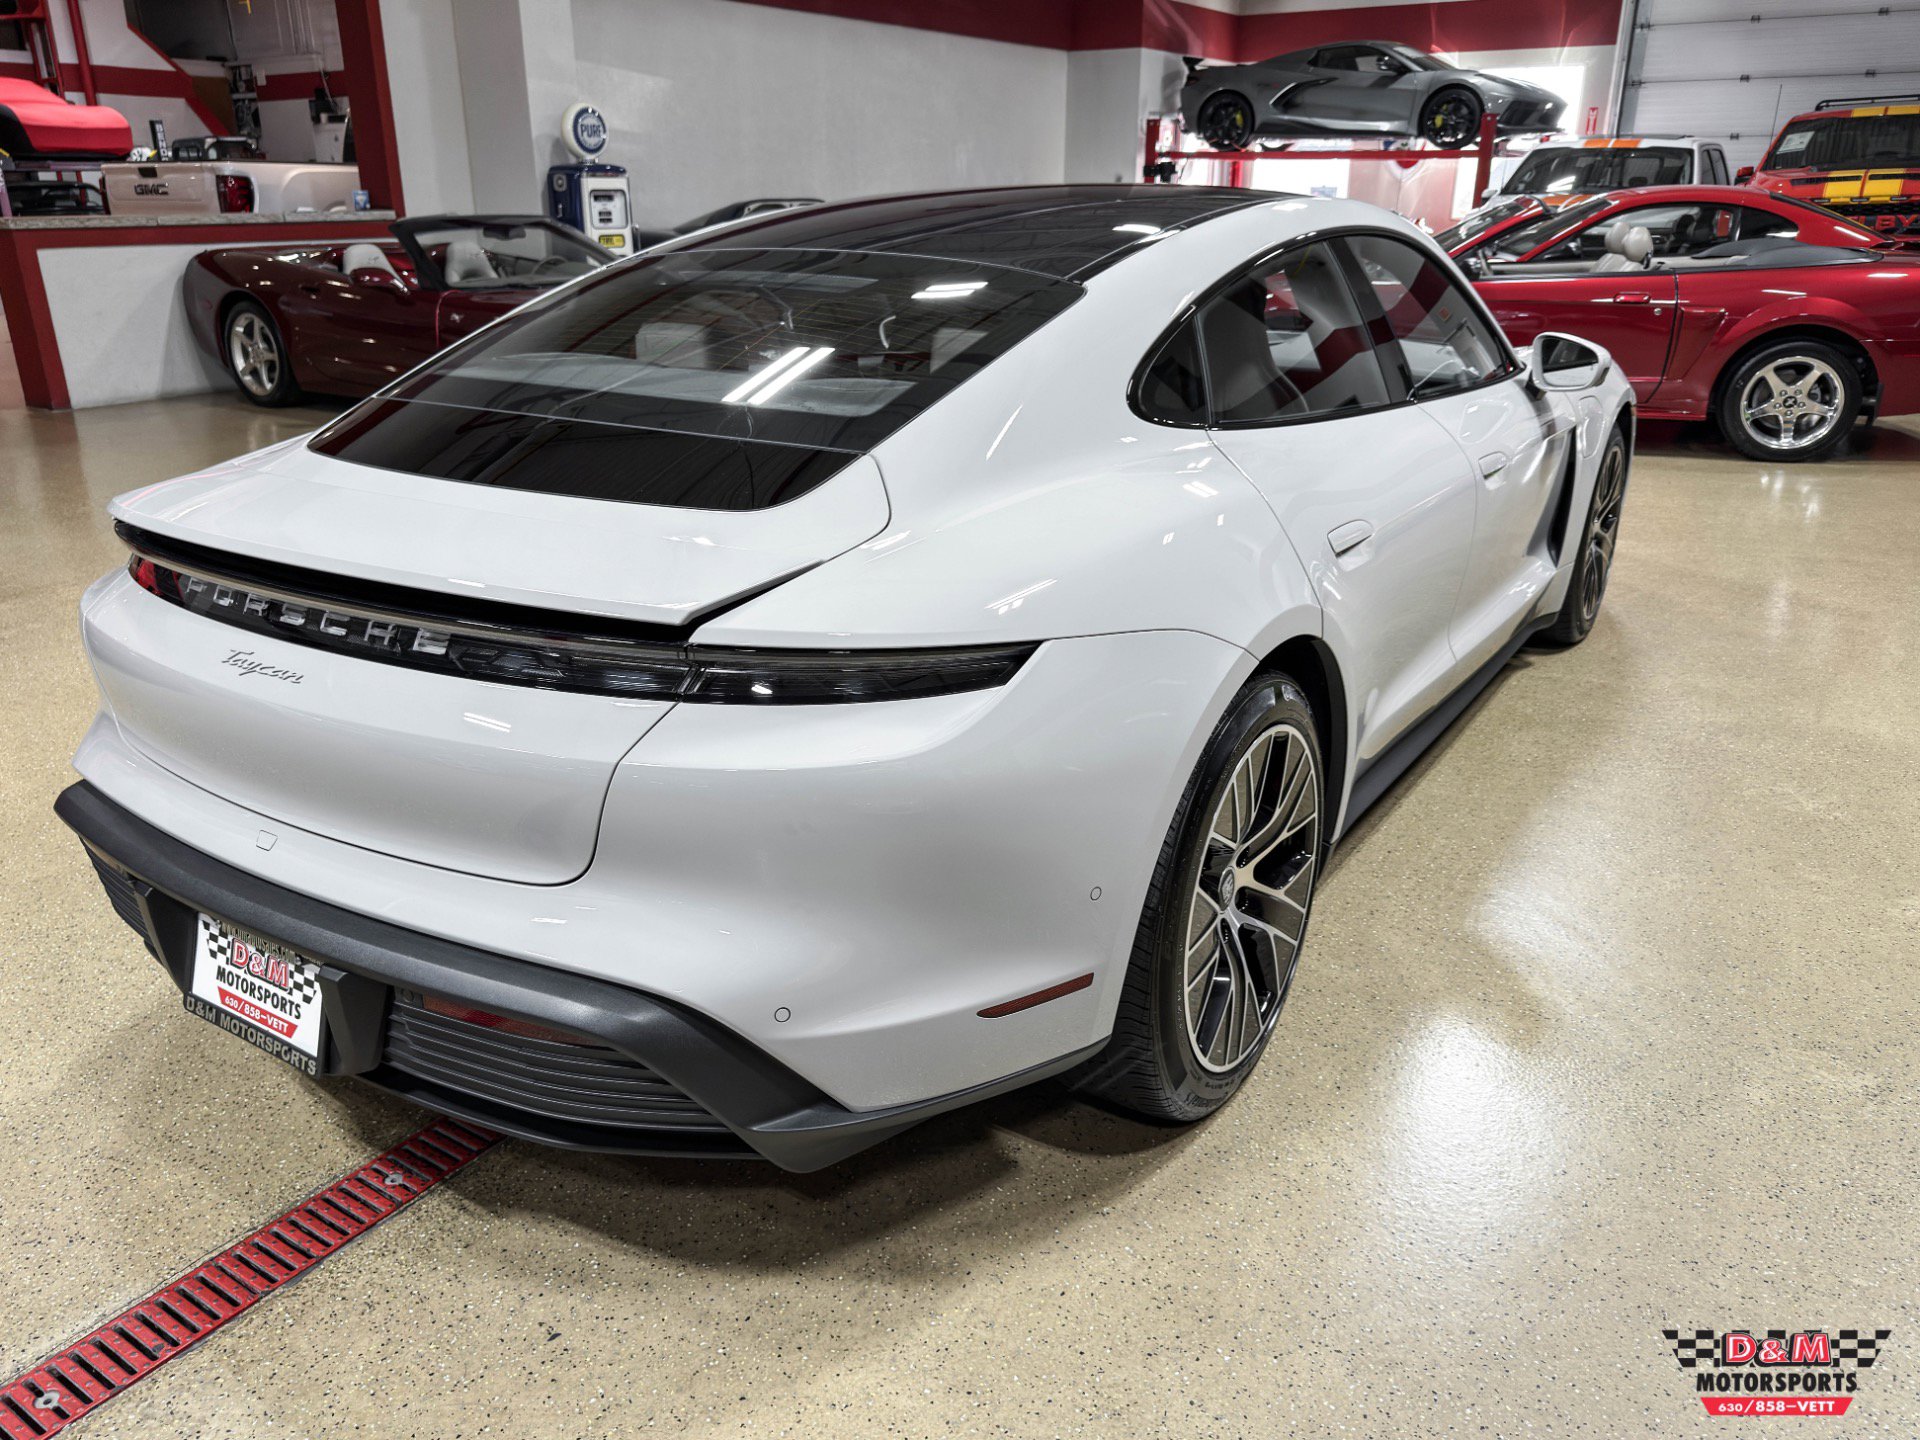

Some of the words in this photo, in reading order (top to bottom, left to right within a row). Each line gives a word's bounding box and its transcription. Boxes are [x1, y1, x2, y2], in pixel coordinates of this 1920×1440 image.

[134, 184, 169, 196] GMC
[186, 576, 451, 655] PORSCHE
[221, 649, 305, 684] Taycan
[231, 937, 290, 993] D&M
[216, 966, 302, 1020] MOTORSPORTS
[186, 995, 217, 1023] D&M
[219, 1013, 317, 1076] MOTORSPORTS
